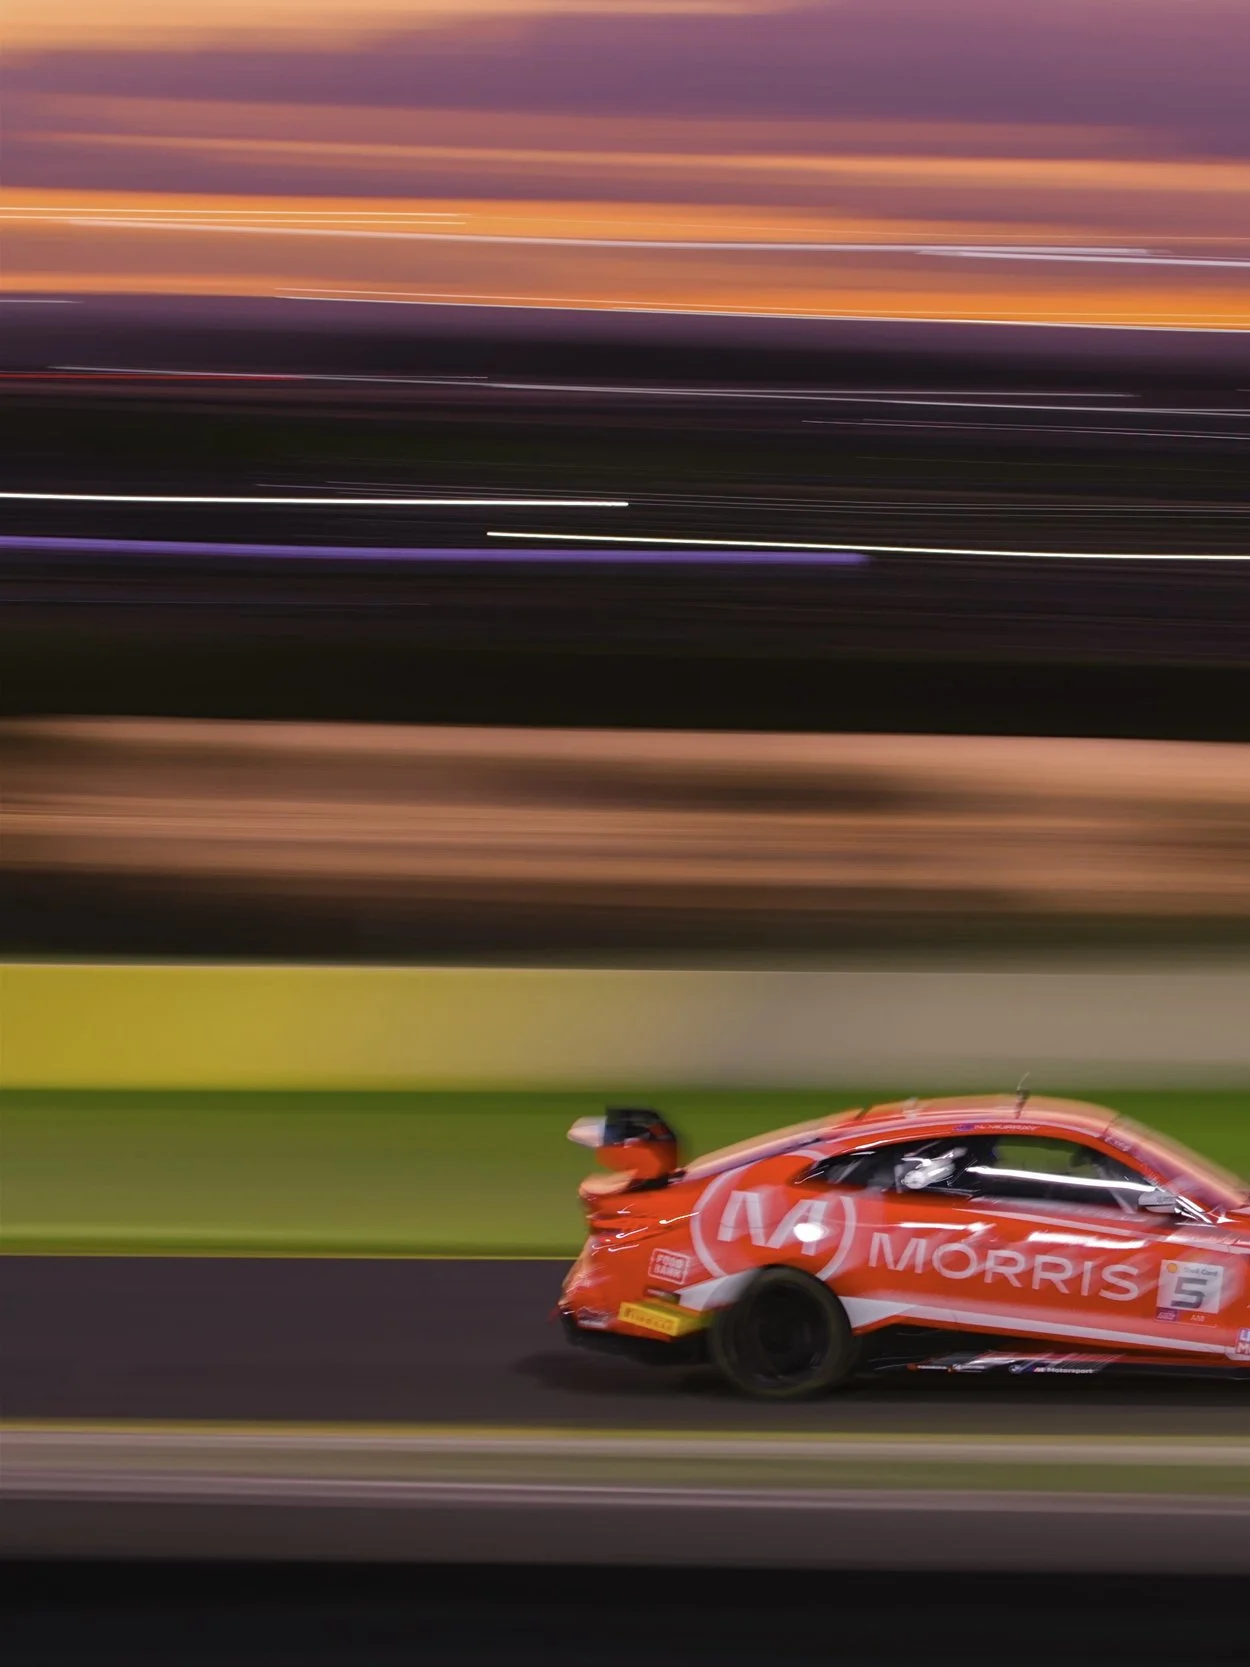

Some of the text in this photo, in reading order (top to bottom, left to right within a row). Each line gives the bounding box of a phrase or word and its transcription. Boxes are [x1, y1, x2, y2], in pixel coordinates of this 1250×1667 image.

[717, 1190, 828, 1256] M
[868, 1232, 1140, 1301] MORRIS
[1170, 1276, 1208, 1309] 5
